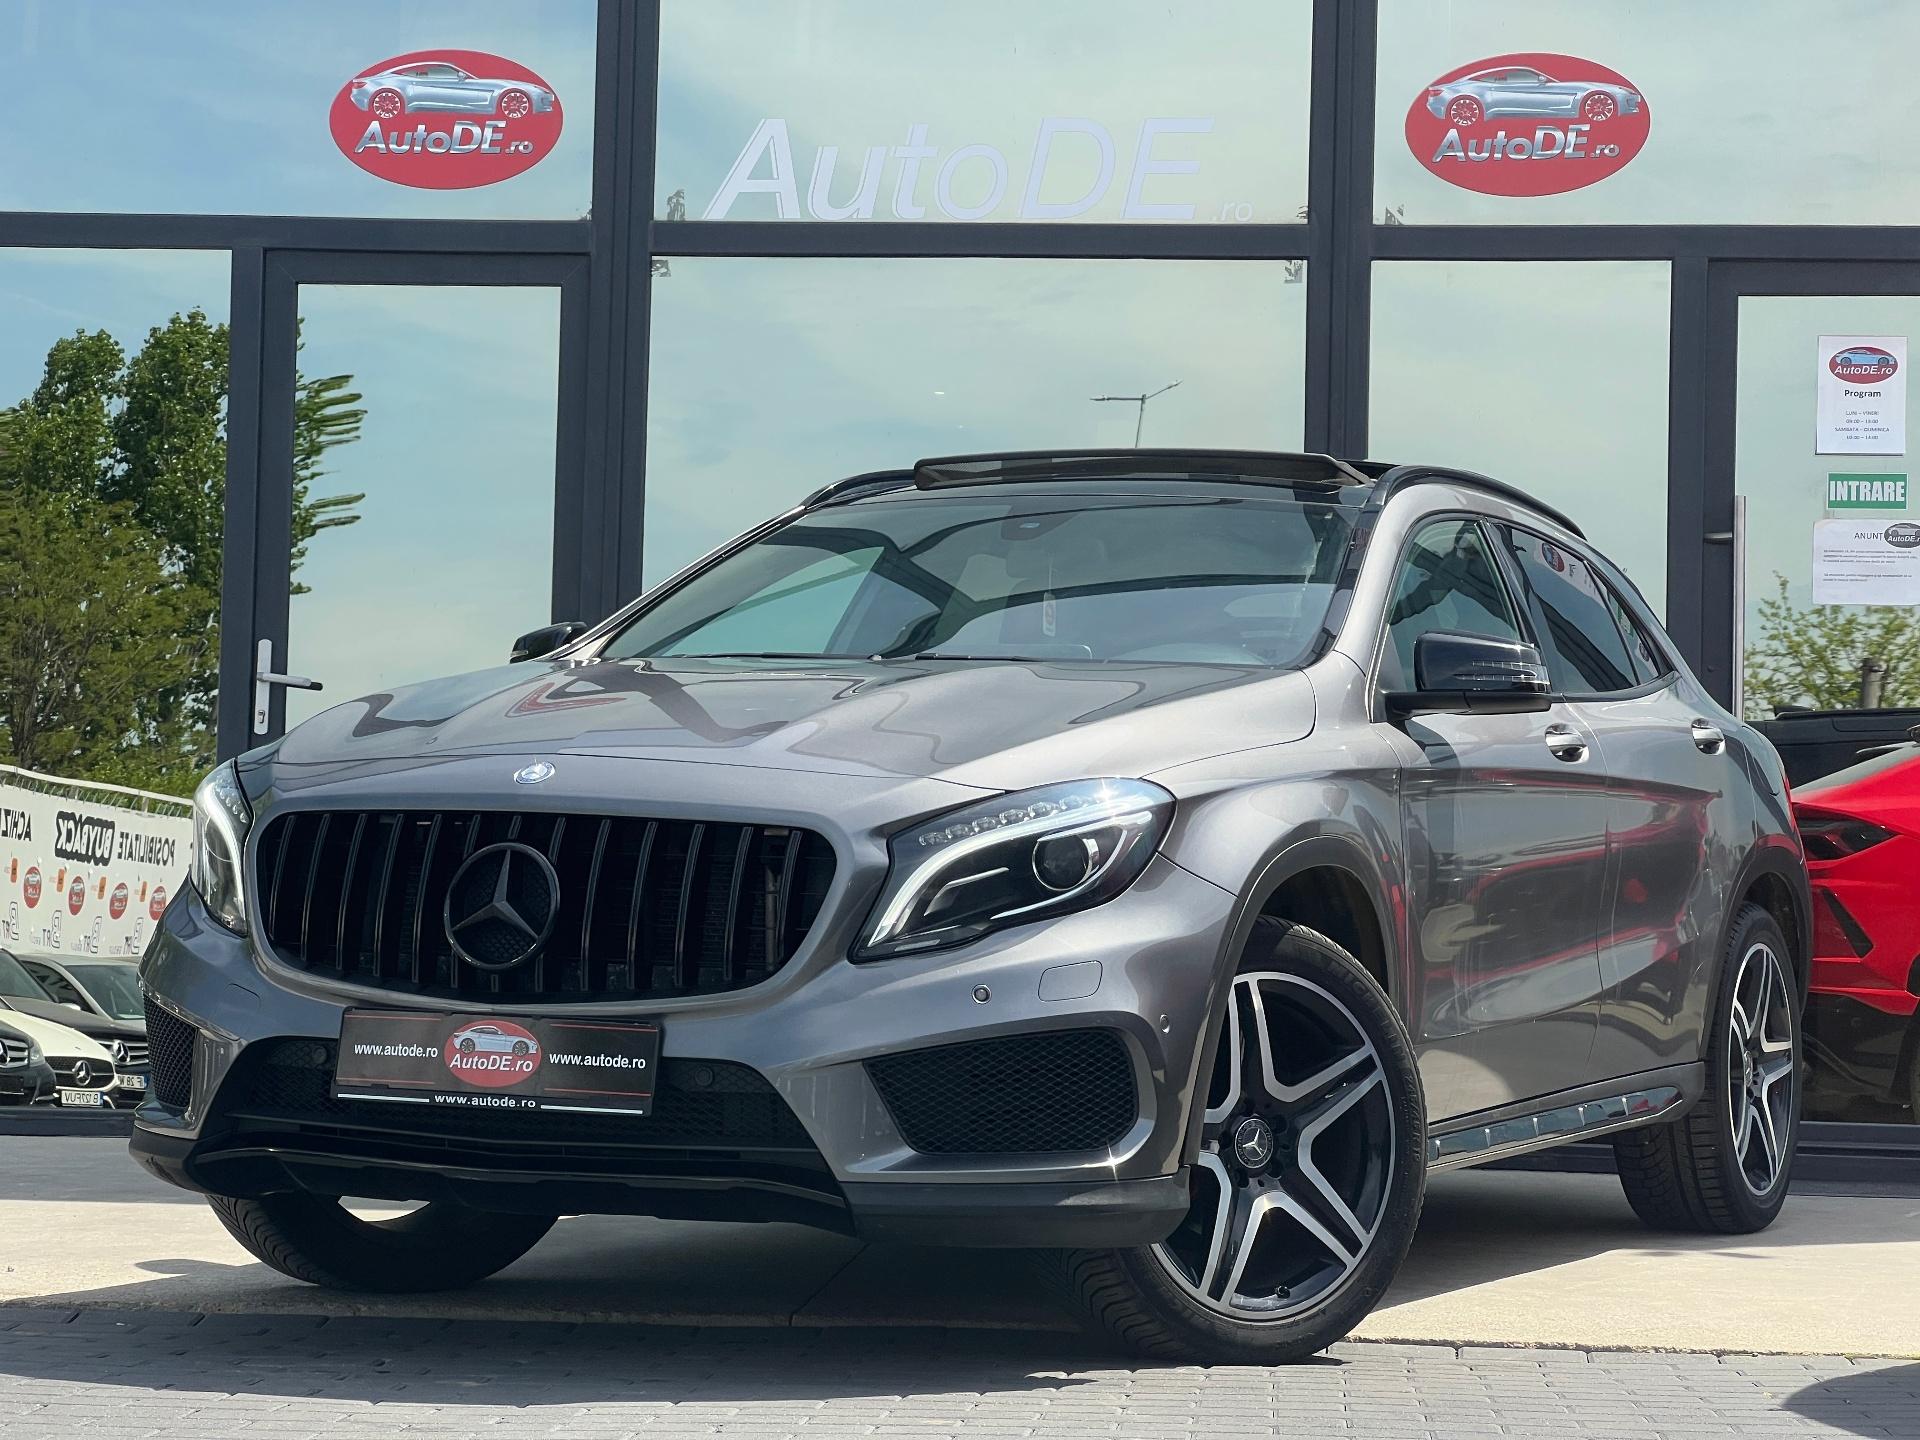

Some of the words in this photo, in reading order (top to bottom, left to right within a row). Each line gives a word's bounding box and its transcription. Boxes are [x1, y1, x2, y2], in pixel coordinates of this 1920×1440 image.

[1834, 364, 1894, 376] AutoDE.ro
[1844, 389, 1882, 399] Program
[1829, 480, 1905, 502] INTRARE
[354, 1042, 438, 1058] www.autode.ro
[450, 1053, 533, 1073] AutoDE.ro
[549, 1052, 646, 1069] www.autode.ro
[434, 1093, 536, 1108] www.autode.ro
